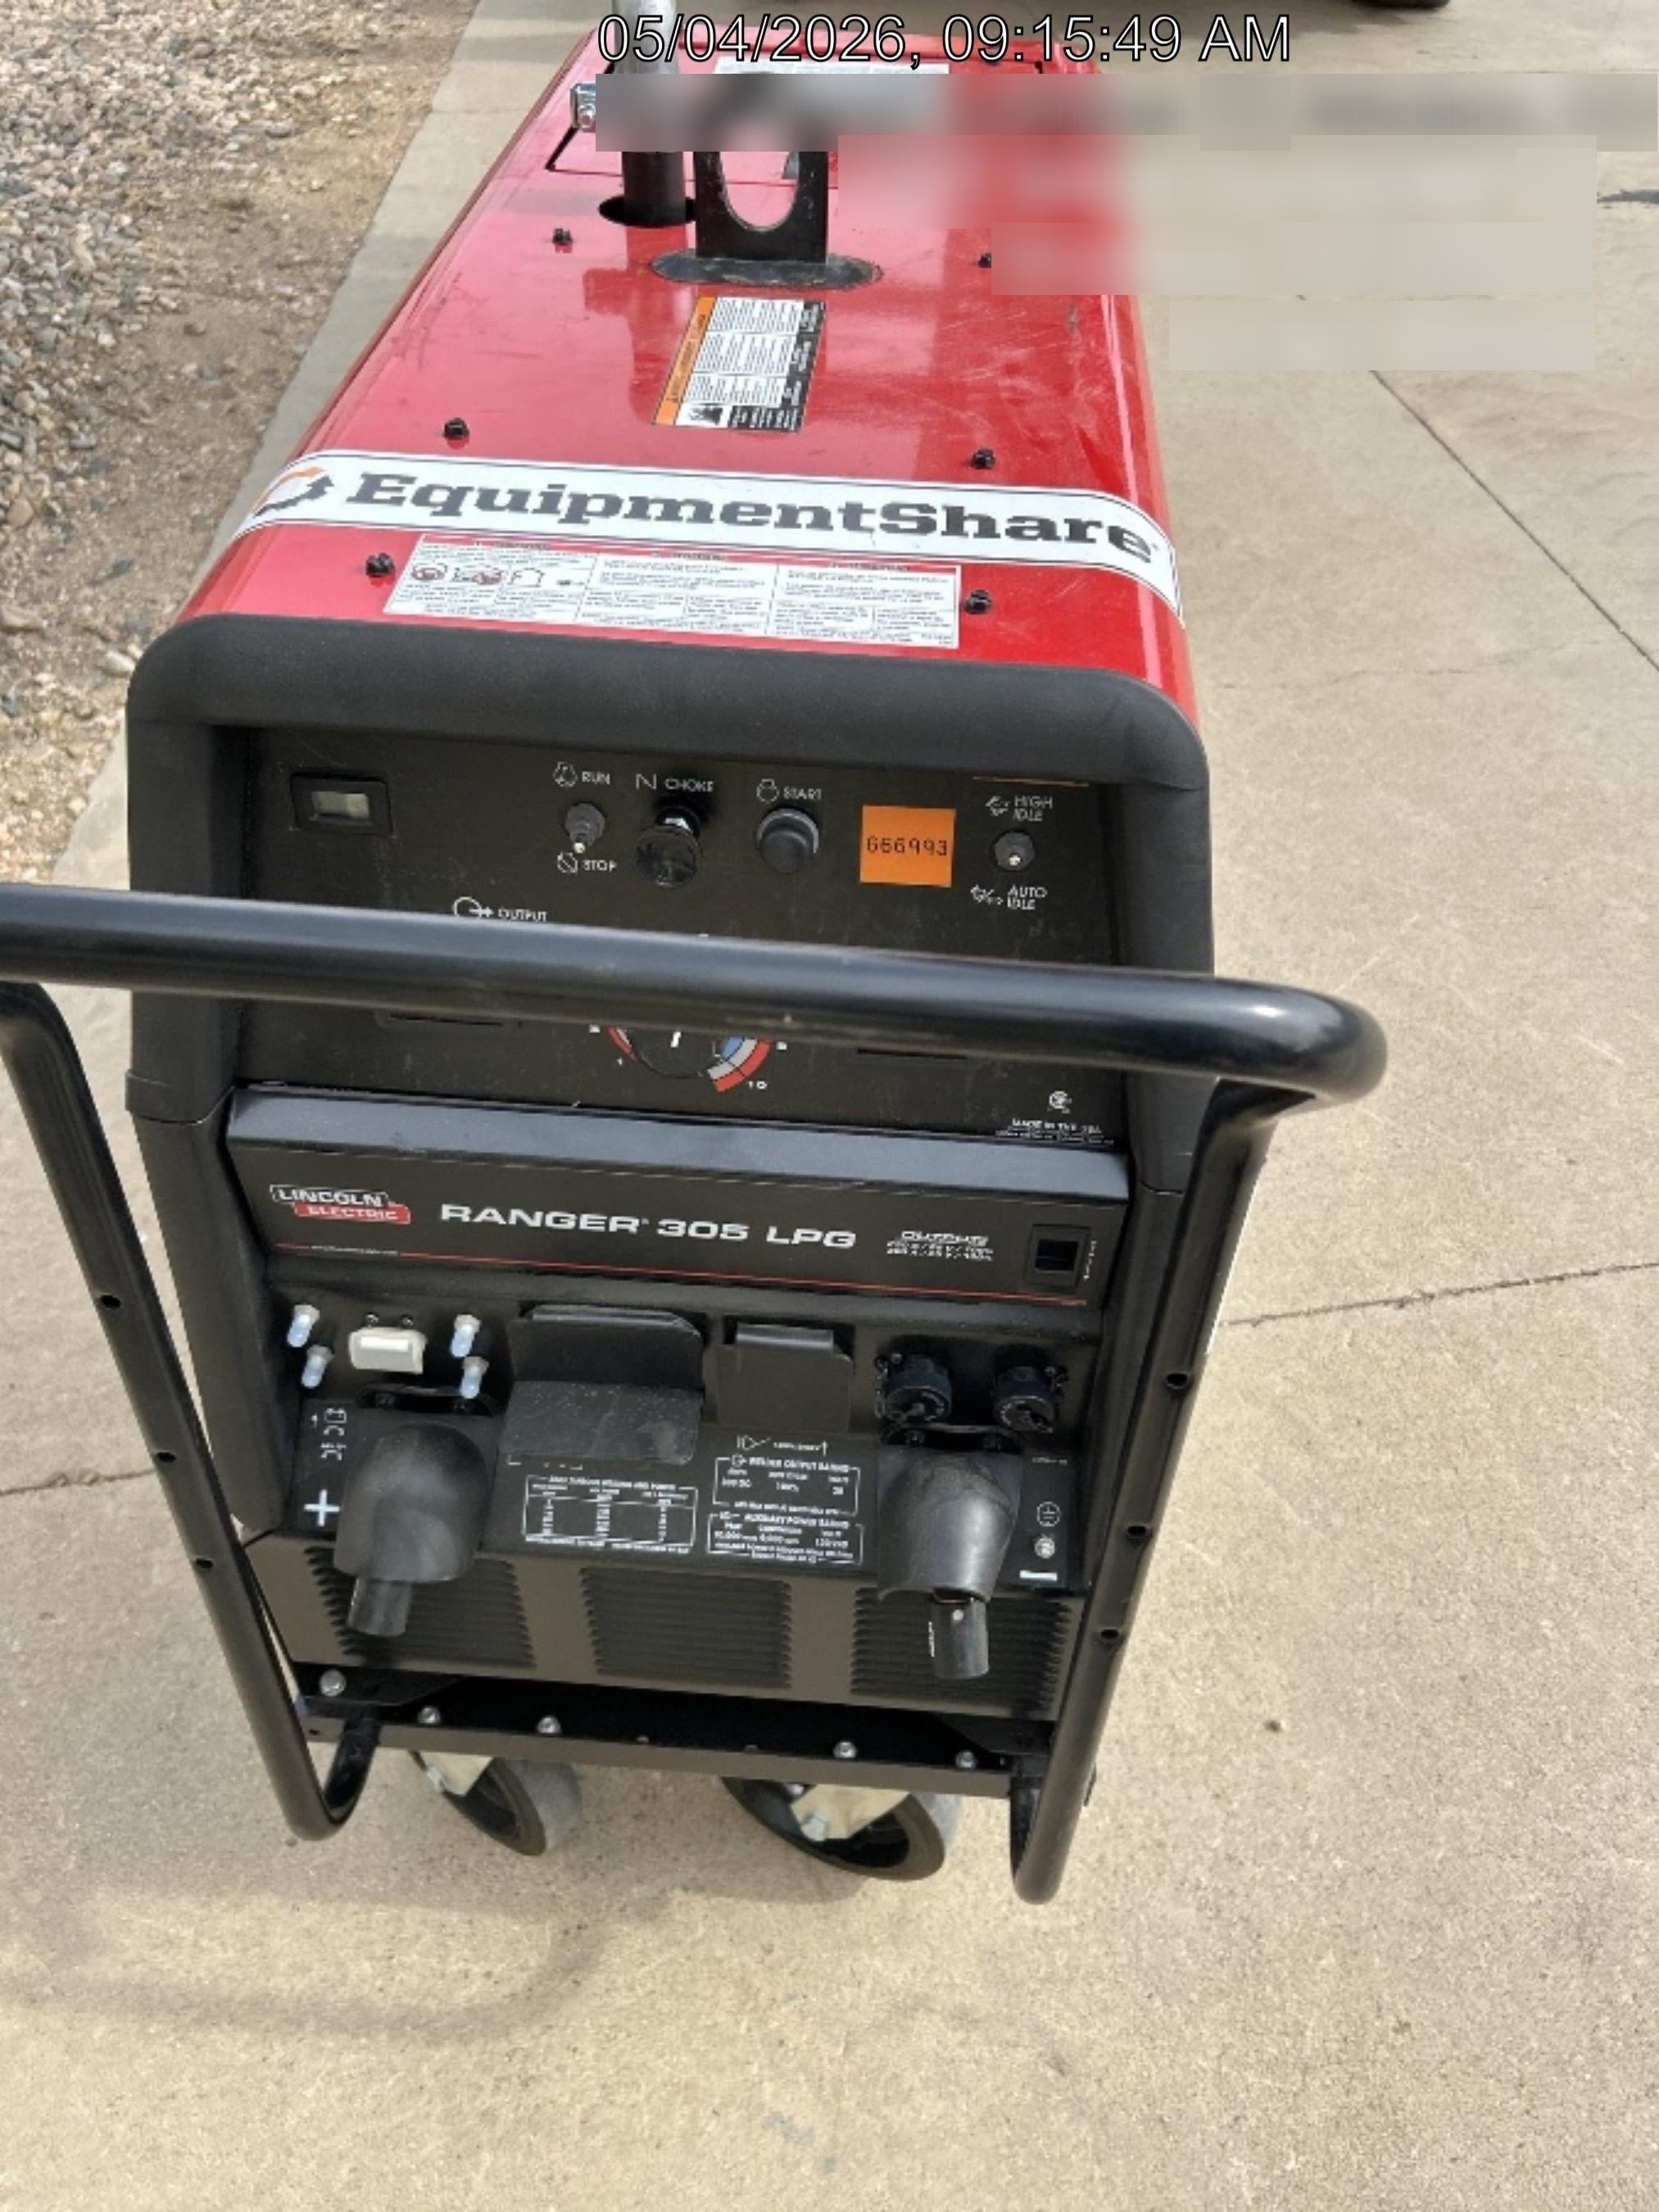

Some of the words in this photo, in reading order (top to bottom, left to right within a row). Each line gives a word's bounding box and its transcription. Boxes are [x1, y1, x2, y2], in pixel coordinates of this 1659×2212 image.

[347, 473, 1153, 564] EquipmentShare
[582, 771, 610, 784] RUN
[664, 779, 714, 792] CHOKE
[783, 787, 823, 800] START
[1014, 796, 1053, 808] HIGH
[1012, 809, 1044, 822] IDLE
[583, 859, 618, 872] STOP
[1006, 884, 1048, 898] AUTO
[1006, 898, 1036, 911] IDLE
[497, 907, 548, 922] OUTPUT
[279, 1188, 383, 1208] LINCOLN
[307, 1205, 400, 1221] ELECTRIC
[657, 1217, 750, 1241] 305
[766, 1226, 857, 1249] LPG
